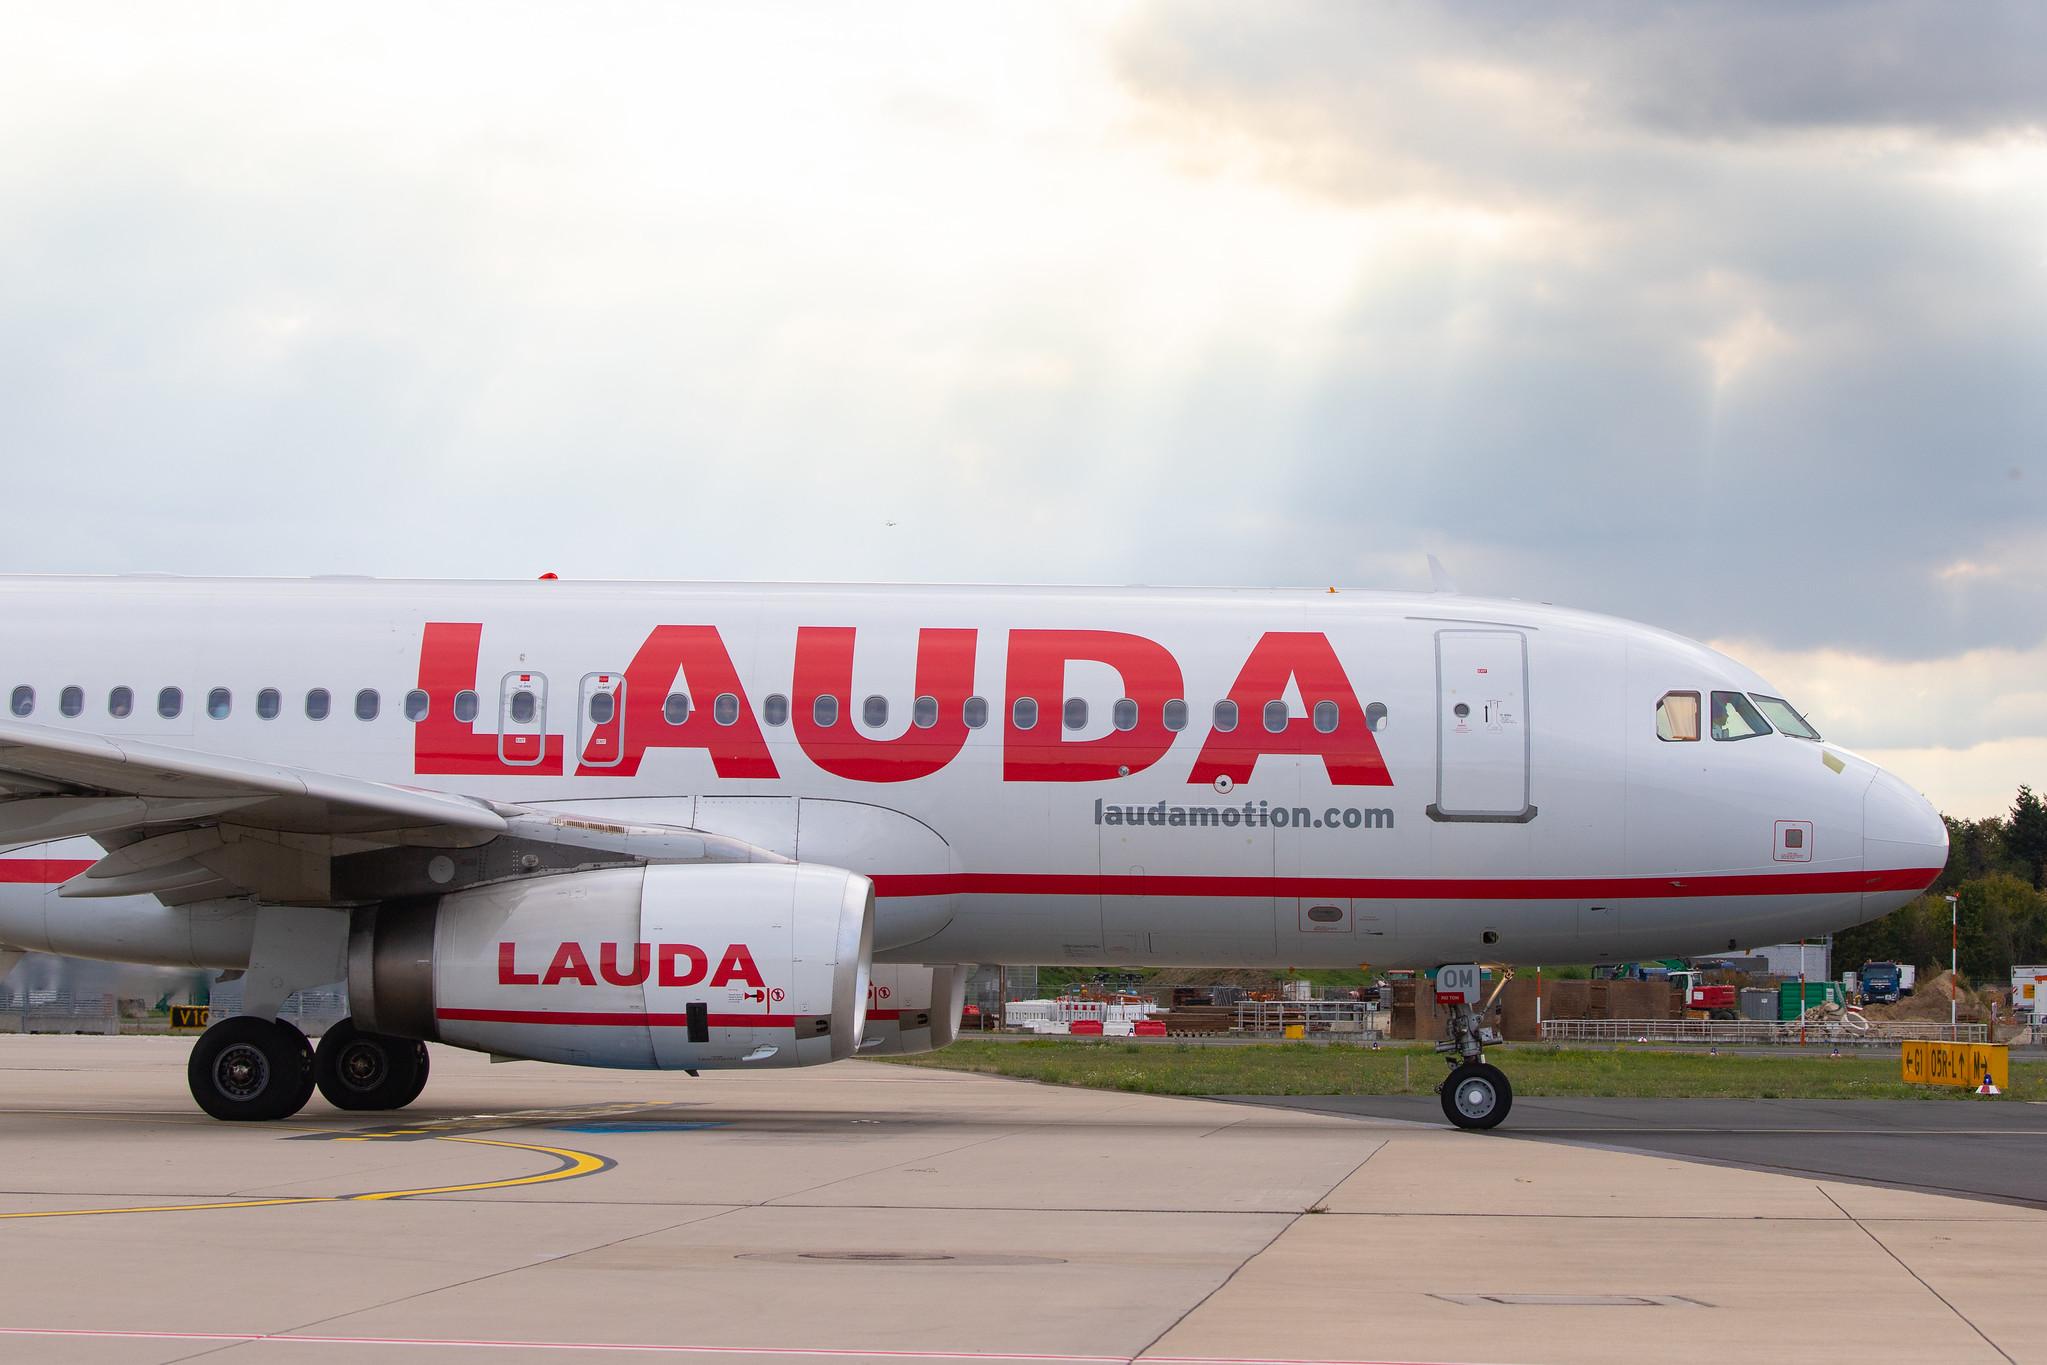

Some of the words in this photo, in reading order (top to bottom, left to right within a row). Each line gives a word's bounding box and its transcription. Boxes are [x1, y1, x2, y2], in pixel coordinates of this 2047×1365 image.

[414, 622, 1393, 787] LAUDA
[1094, 798, 1395, 829] laudamotion.com
[498, 942, 766, 987] LAUDA
[1444, 969, 1473, 988] OM
[1973, 1051, 1981, 1080] M
